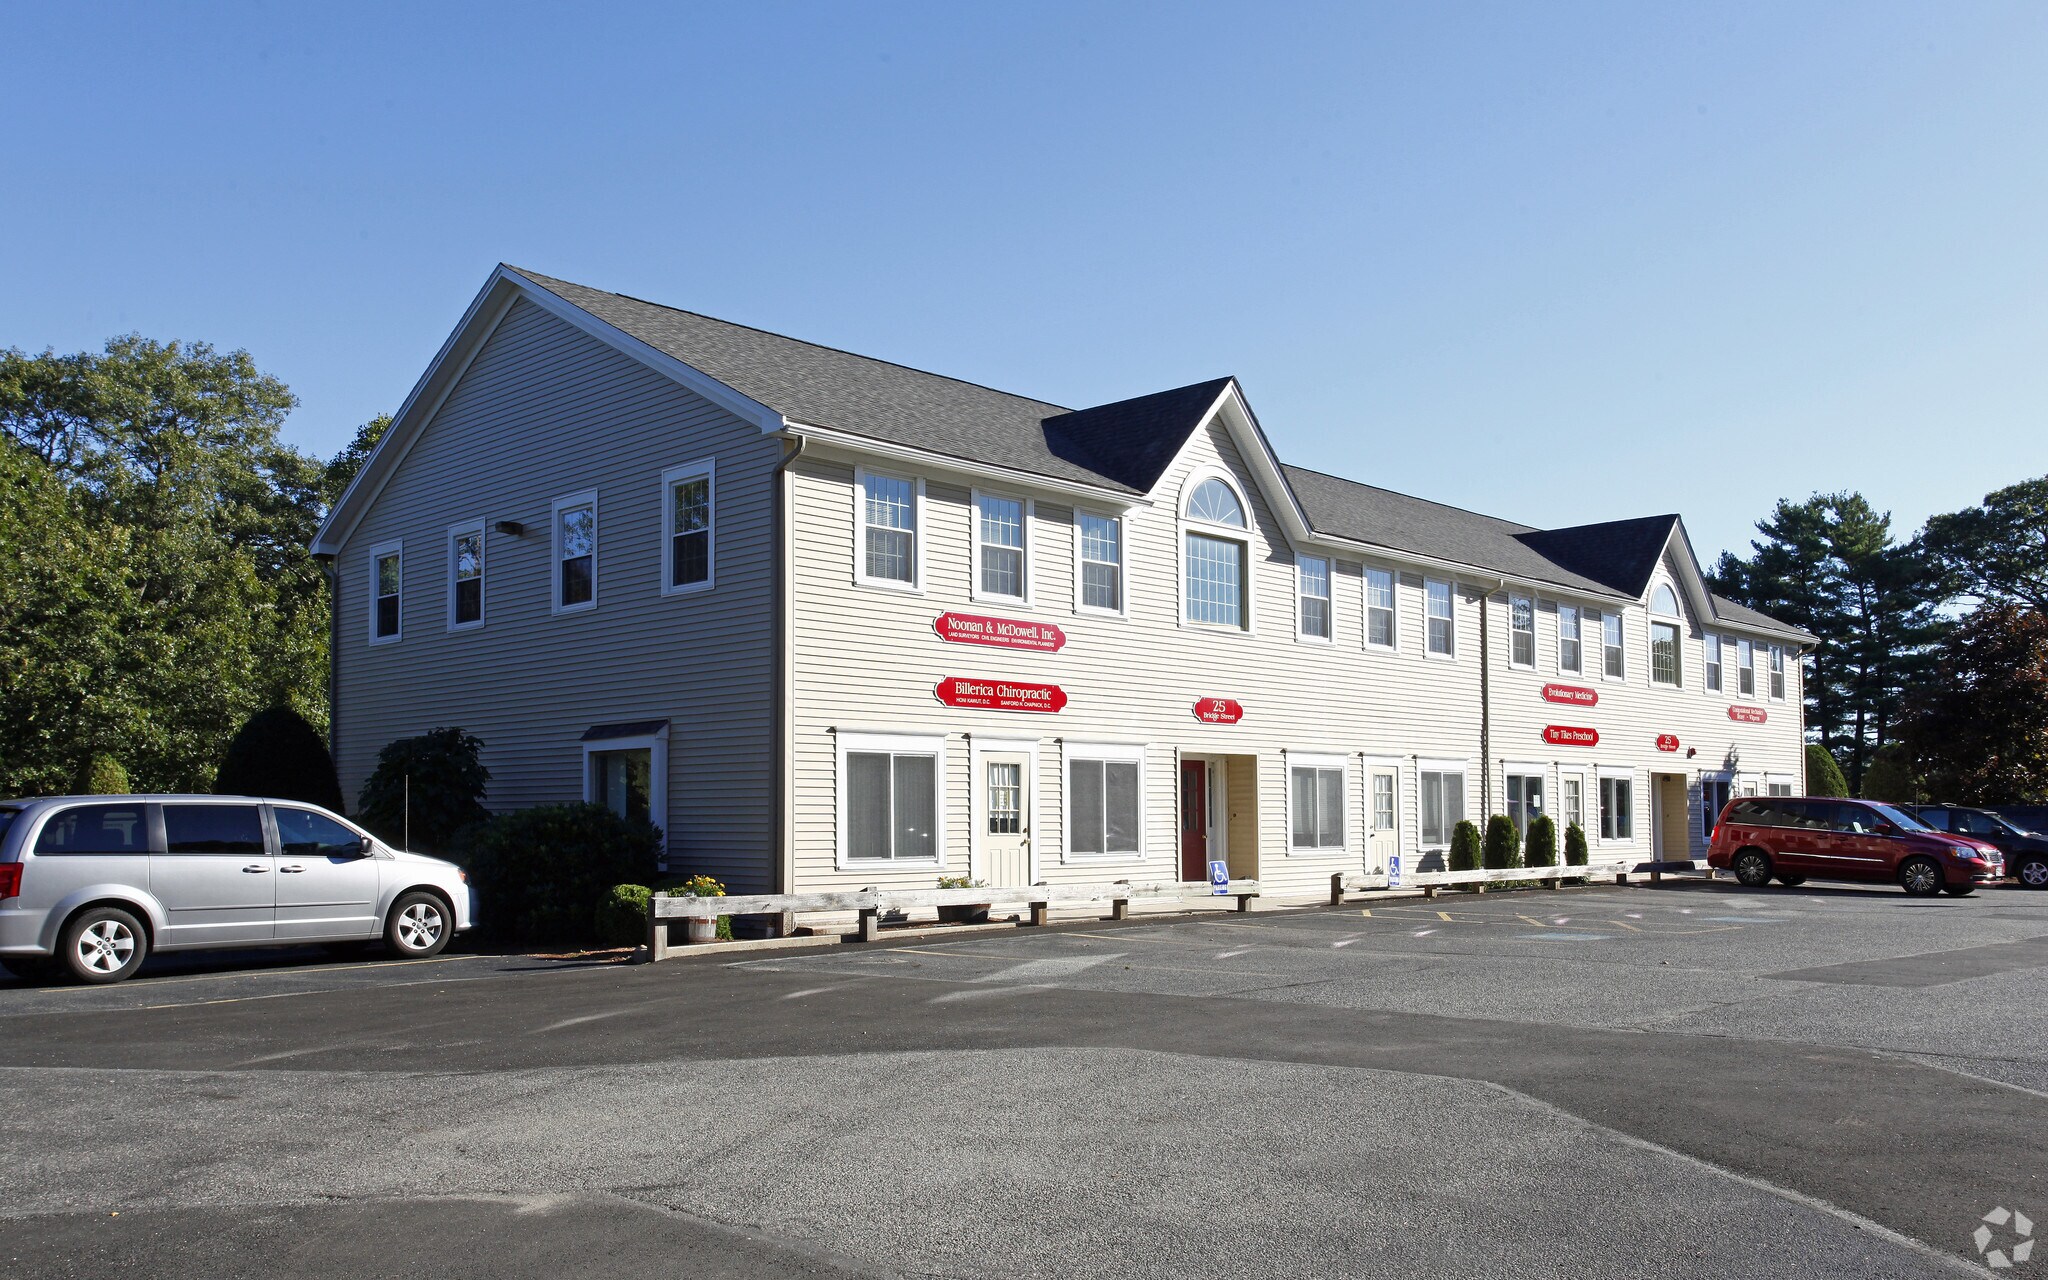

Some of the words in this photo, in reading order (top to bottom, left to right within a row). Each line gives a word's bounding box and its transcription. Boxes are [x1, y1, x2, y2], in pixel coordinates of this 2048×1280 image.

[948, 617, 983, 632] Noonan
[986, 621, 994, 634] &
[1042, 628, 1056, 640] Inc.
[955, 682, 994, 696] Billerica
[996, 684, 1052, 701] Chiropractic
[1548, 687, 1574, 700] Evolutionary
[1575, 691, 1593, 700] Medicine
[1212, 700, 1226, 712] 25
[1204, 712, 1219, 721] Bridge
[1550, 729, 1560, 740] Tiny
[1573, 731, 1594, 741] Preschool
[1664, 736, 1672, 744] 25
